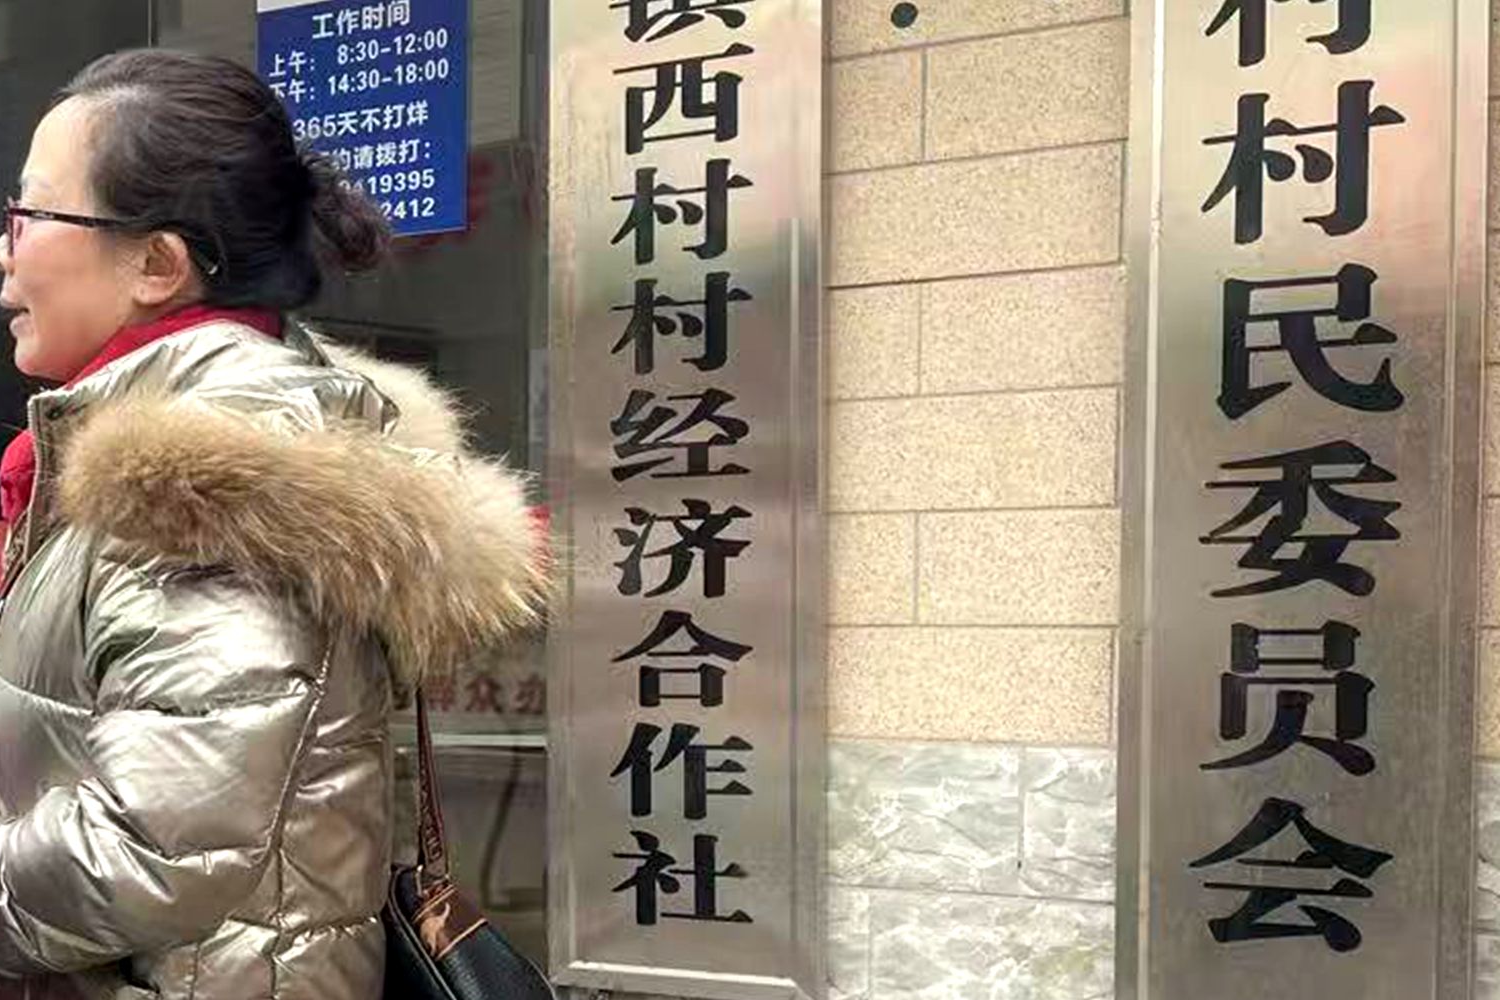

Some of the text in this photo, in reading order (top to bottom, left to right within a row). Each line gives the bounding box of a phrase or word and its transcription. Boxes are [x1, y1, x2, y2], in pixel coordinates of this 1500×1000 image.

[311, 1, 411, 40] 工作时间
[337, 28, 449, 66] 8:30-12:00
[328, 58, 450, 97] 14:30-18:00
[292, 100, 429, 142] 365天不打烊
[320, 138, 432, 172] 约请拨打：
